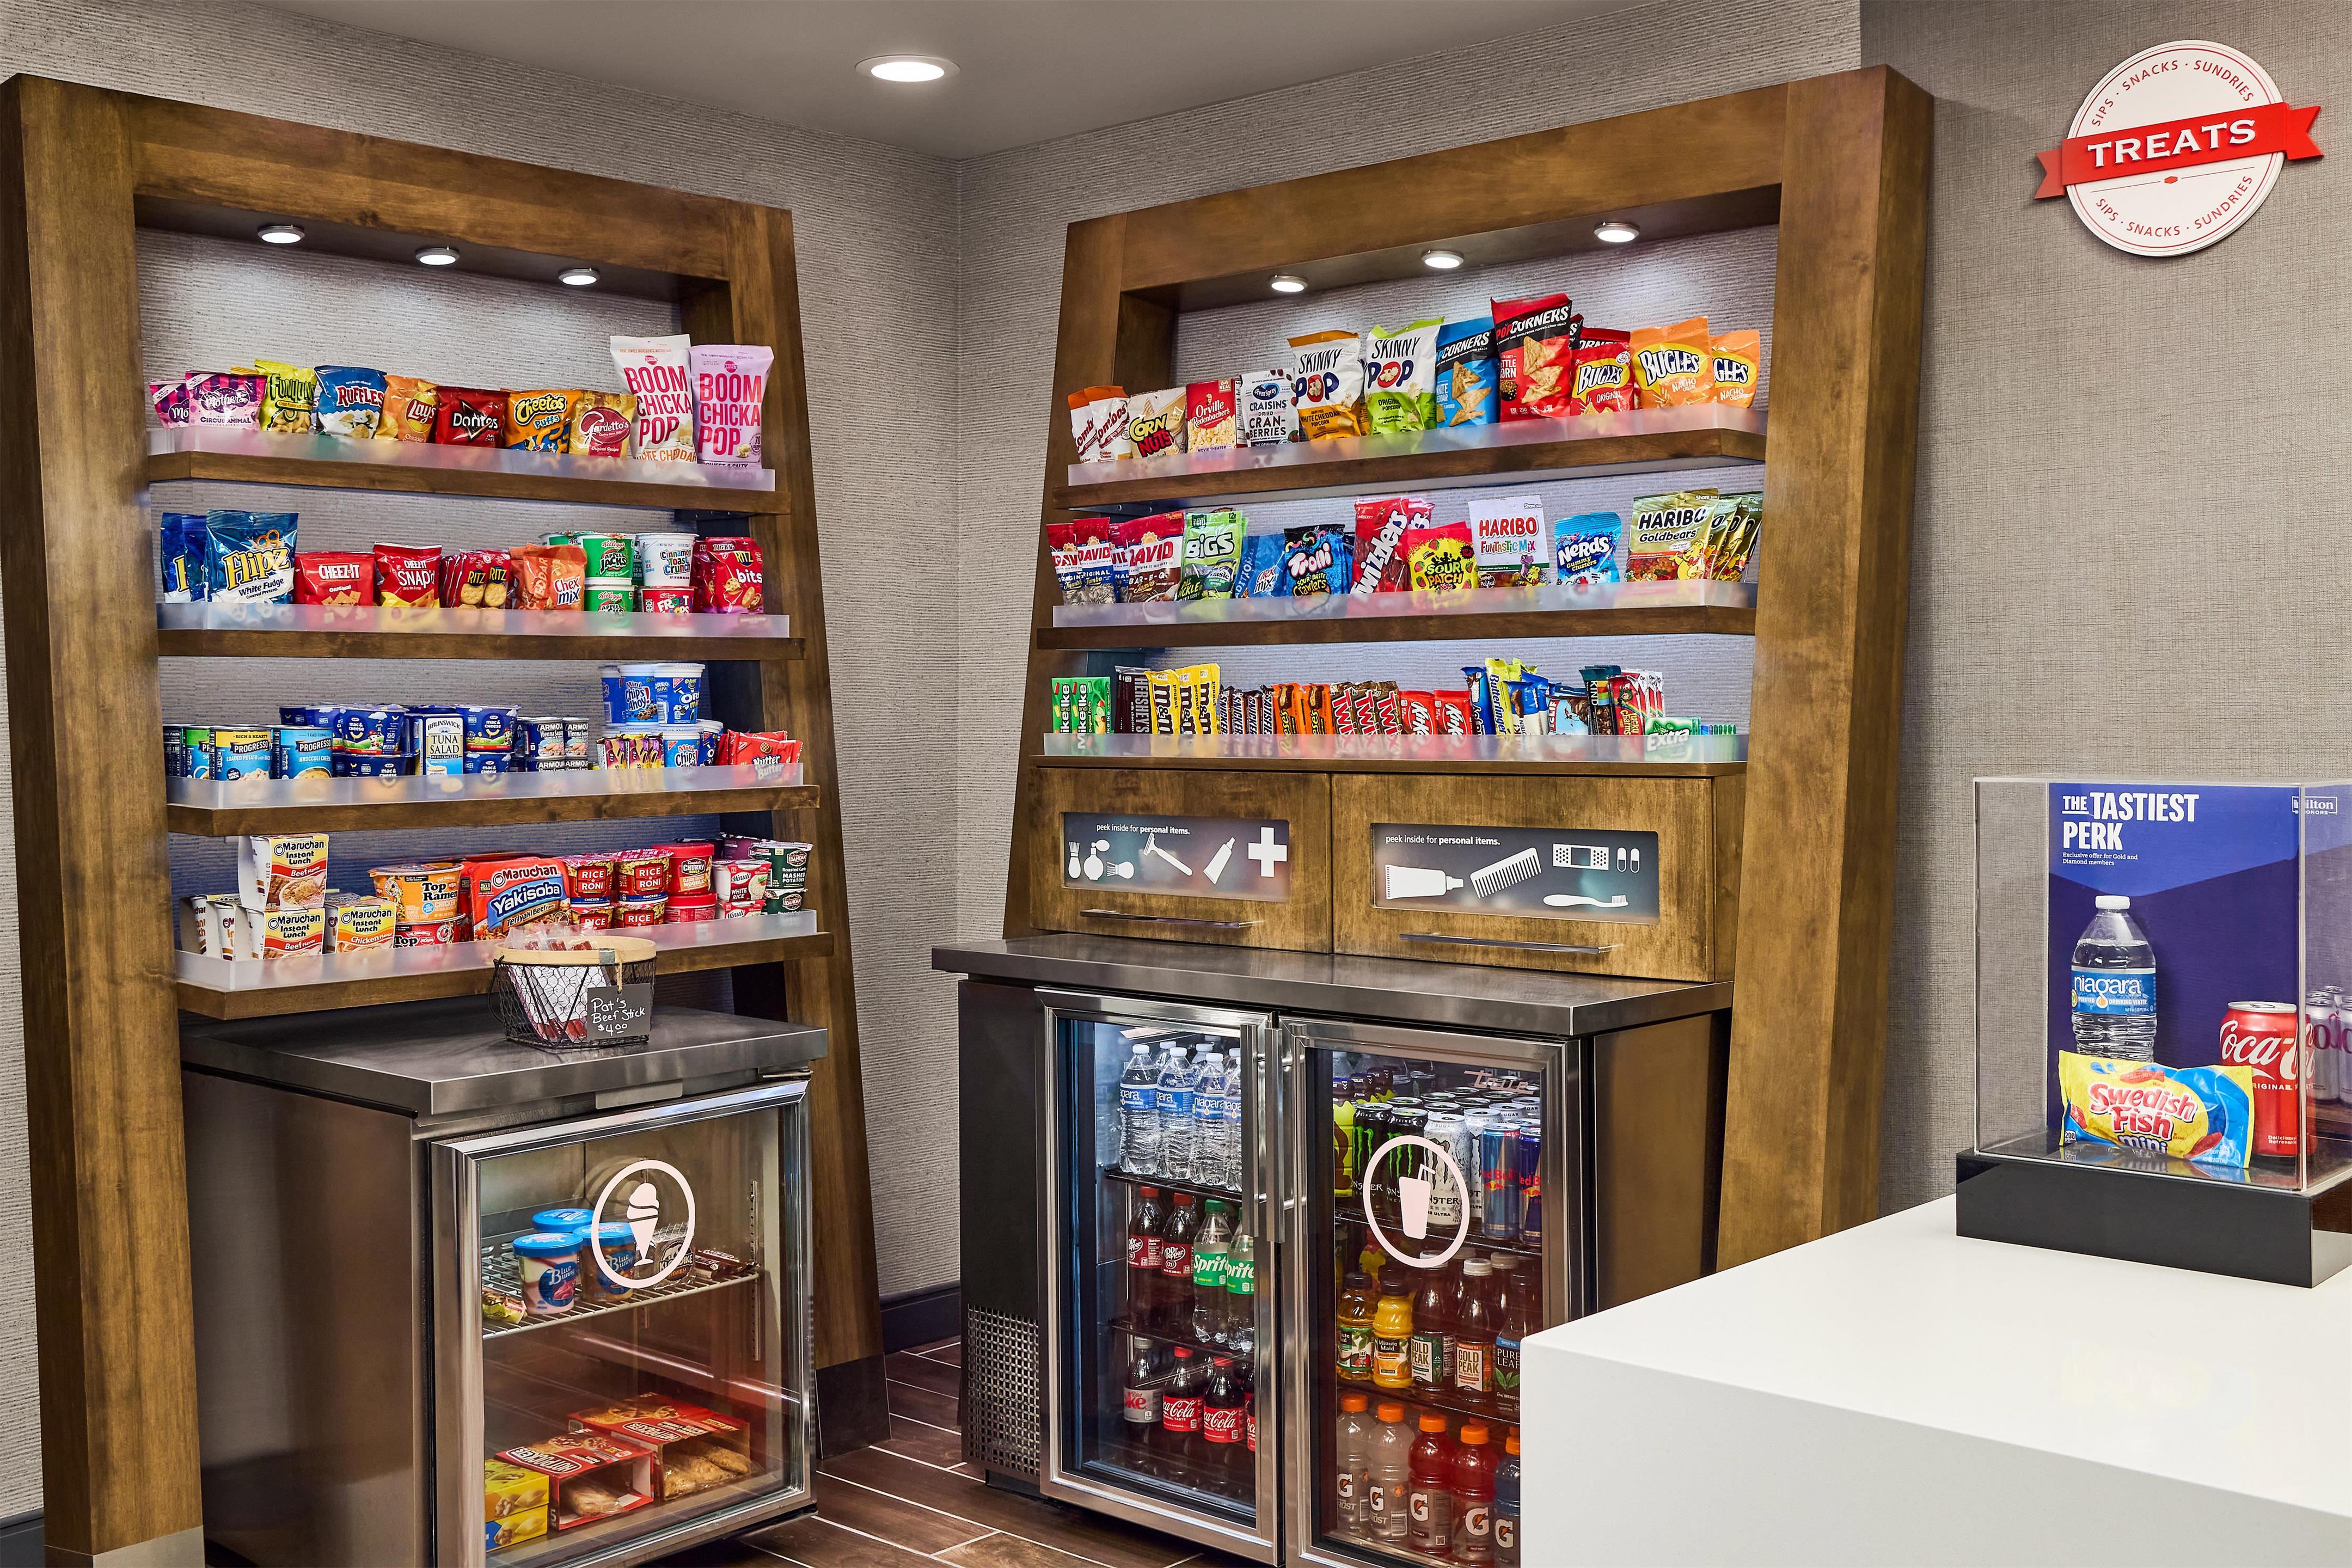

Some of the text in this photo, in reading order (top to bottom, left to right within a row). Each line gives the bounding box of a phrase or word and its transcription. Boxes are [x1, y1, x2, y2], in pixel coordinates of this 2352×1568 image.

[2092, 59, 2254, 126] SIPS SNACKS SUNDRIES
[2087, 119, 2256, 168] TREATS
[2096, 175, 2253, 237] SIPS SNACKS SUNDRIES
[1496, 306, 1569, 340] POPCORNERS
[1372, 337, 1421, 359] SKINNY
[1298, 348, 1343, 375] SKINNY
[1639, 350, 1699, 386] BUGLES
[623, 365, 688, 394] BOOM
[1578, 364, 1623, 395] BUGLES
[1672, 378, 1696, 393] NACHO
[699, 372, 763, 403] BOOM
[1265, 387, 1276, 397] Spray
[336, 386, 384, 407] RUFFLES
[408, 399, 436, 424] Lay's
[516, 394, 566, 424] Cheetos
[636, 393, 693, 416] CHICKA
[1196, 400, 1224, 418] Orville
[1250, 400, 1287, 412] CRAISINS
[453, 413, 498, 429] Doritos
[700, 403, 761, 426] CHICKA
[1192, 407, 1230, 428] Redenbacher's
[1249, 415, 1285, 428] CRAN-
[1314, 411, 1341, 420] CHEDDAR
[639, 416, 680, 447] POP
[1129, 414, 1168, 442] CORN
[1250, 427, 1287, 438] BERRIES
[697, 425, 741, 456] POP
[1137, 430, 1174, 457] NUTS
[1638, 508, 1706, 530] HARIBO
[1479, 517, 1538, 537] HARIBO
[1639, 529, 1696, 542] Goldbears
[602, 540, 626, 548] Kellogg's
[1480, 539, 1520, 554] FUNTASTIC
[660, 549, 691, 560] Cinnamon
[668, 558, 688, 566] Toast
[736, 550, 754, 563] RITZ
[1288, 542, 1332, 577] Trolli
[1566, 556, 1591, 568] Gummy
[223, 548, 291, 591] Flipz
[600, 557, 627, 573] JACKS
[663, 564, 690, 575] Crunch
[1426, 561, 1462, 574] SOUR
[1572, 560, 1597, 571] Clusters
[468, 571, 487, 584] RITZ
[489, 567, 507, 581] RITZ
[736, 569, 763, 584] bits
[1297, 573, 1326, 586] SOUR BRITE
[1428, 572, 1463, 585] PATCH
[238, 577, 284, 597] White Fudge
[554, 577, 580, 593] Chex
[1293, 579, 1327, 596] Crawlers
[246, 587, 278, 599] Covered Pretzels
[625, 687, 645, 700] Chips
[1590, 681, 1599, 706] KIND
[1134, 677, 1150, 733] HERSHEY'S
[1490, 673, 1507, 734] Butterfinger
[427, 720, 461, 731] BRUNSWICK
[1631, 712, 1639, 734] Lucky
[234, 740, 269, 754] PROGRESSO
[299, 739, 332, 752] PROGRESSO
[431, 735, 458, 745] TUNA
[430, 745, 460, 755] SALAD
[2062, 792, 2200, 822] THE TASTIEST
[2306, 798, 2333, 810] ilton
[1097, 824, 1191, 835] peek inside for personal items.
[2063, 821, 2123, 850] PERK
[283, 841, 324, 851] Maruchan
[1386, 834, 1500, 847] peek inside for personal items.
[291, 869, 308, 877] Beef
[504, 866, 558, 880] Maruchan
[639, 867, 661, 876] RICE
[731, 872, 751, 883] Minute
[421, 882, 446, 893] Top
[639, 878, 661, 888] RONI
[422, 891, 458, 902] Ramen
[493, 882, 561, 917] Yakisoba
[350, 908, 393, 920] Maruchan
[351, 934, 379, 944] Chicken
[2074, 975, 2141, 999] niagara
[591, 997, 627, 1013] Pat's
[591, 1007, 645, 1024] Beef Stick
[2090, 1083, 2198, 1122] Swedish
[2110, 1105, 2174, 1140] Fish
[1164, 1248, 1185, 1260] Pepper
[1458, 1350, 1479, 1363] GOLD
[1458, 1362, 1479, 1374] PEAK
